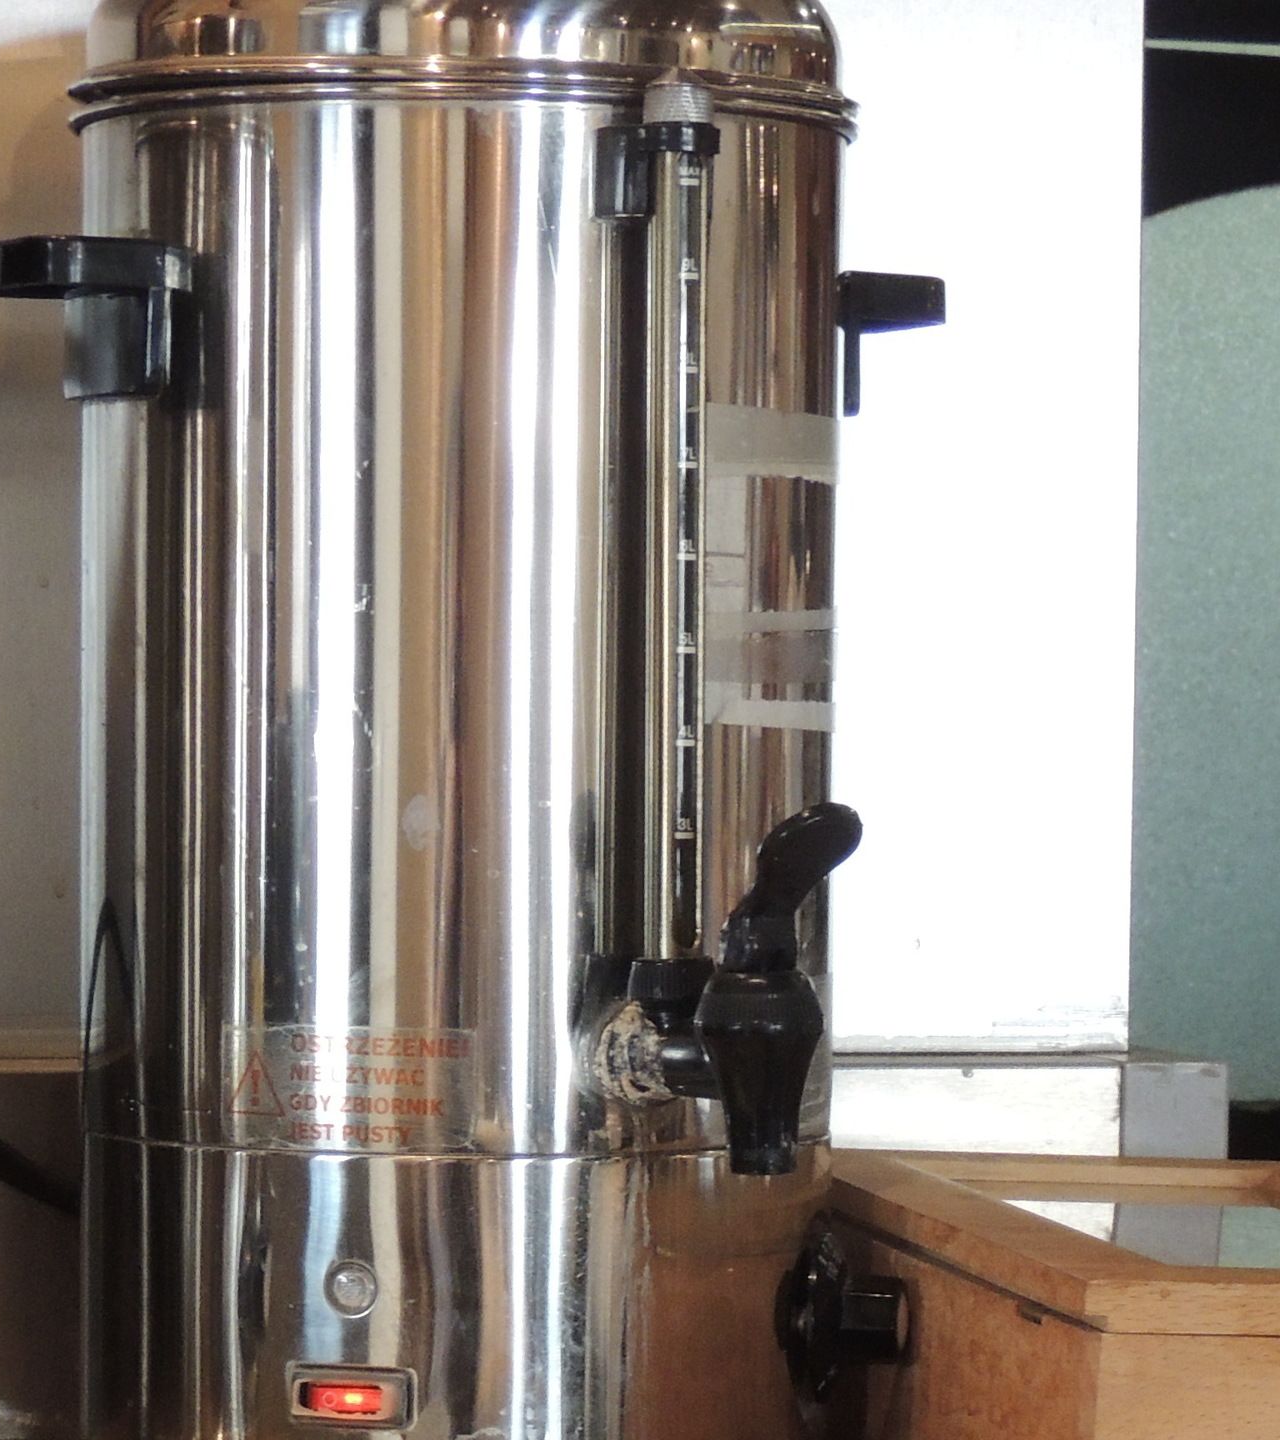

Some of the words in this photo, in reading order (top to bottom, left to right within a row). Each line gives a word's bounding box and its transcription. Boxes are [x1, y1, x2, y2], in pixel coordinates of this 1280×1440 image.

[677, 818, 693, 831] 3L
[290, 1063, 322, 1082] NIE
[289, 1092, 332, 1112] GDY
[340, 1094, 444, 1116] ZBIORNIK
[288, 1121, 335, 1141] JEST
[342, 1123, 412, 1144] PUSTY
